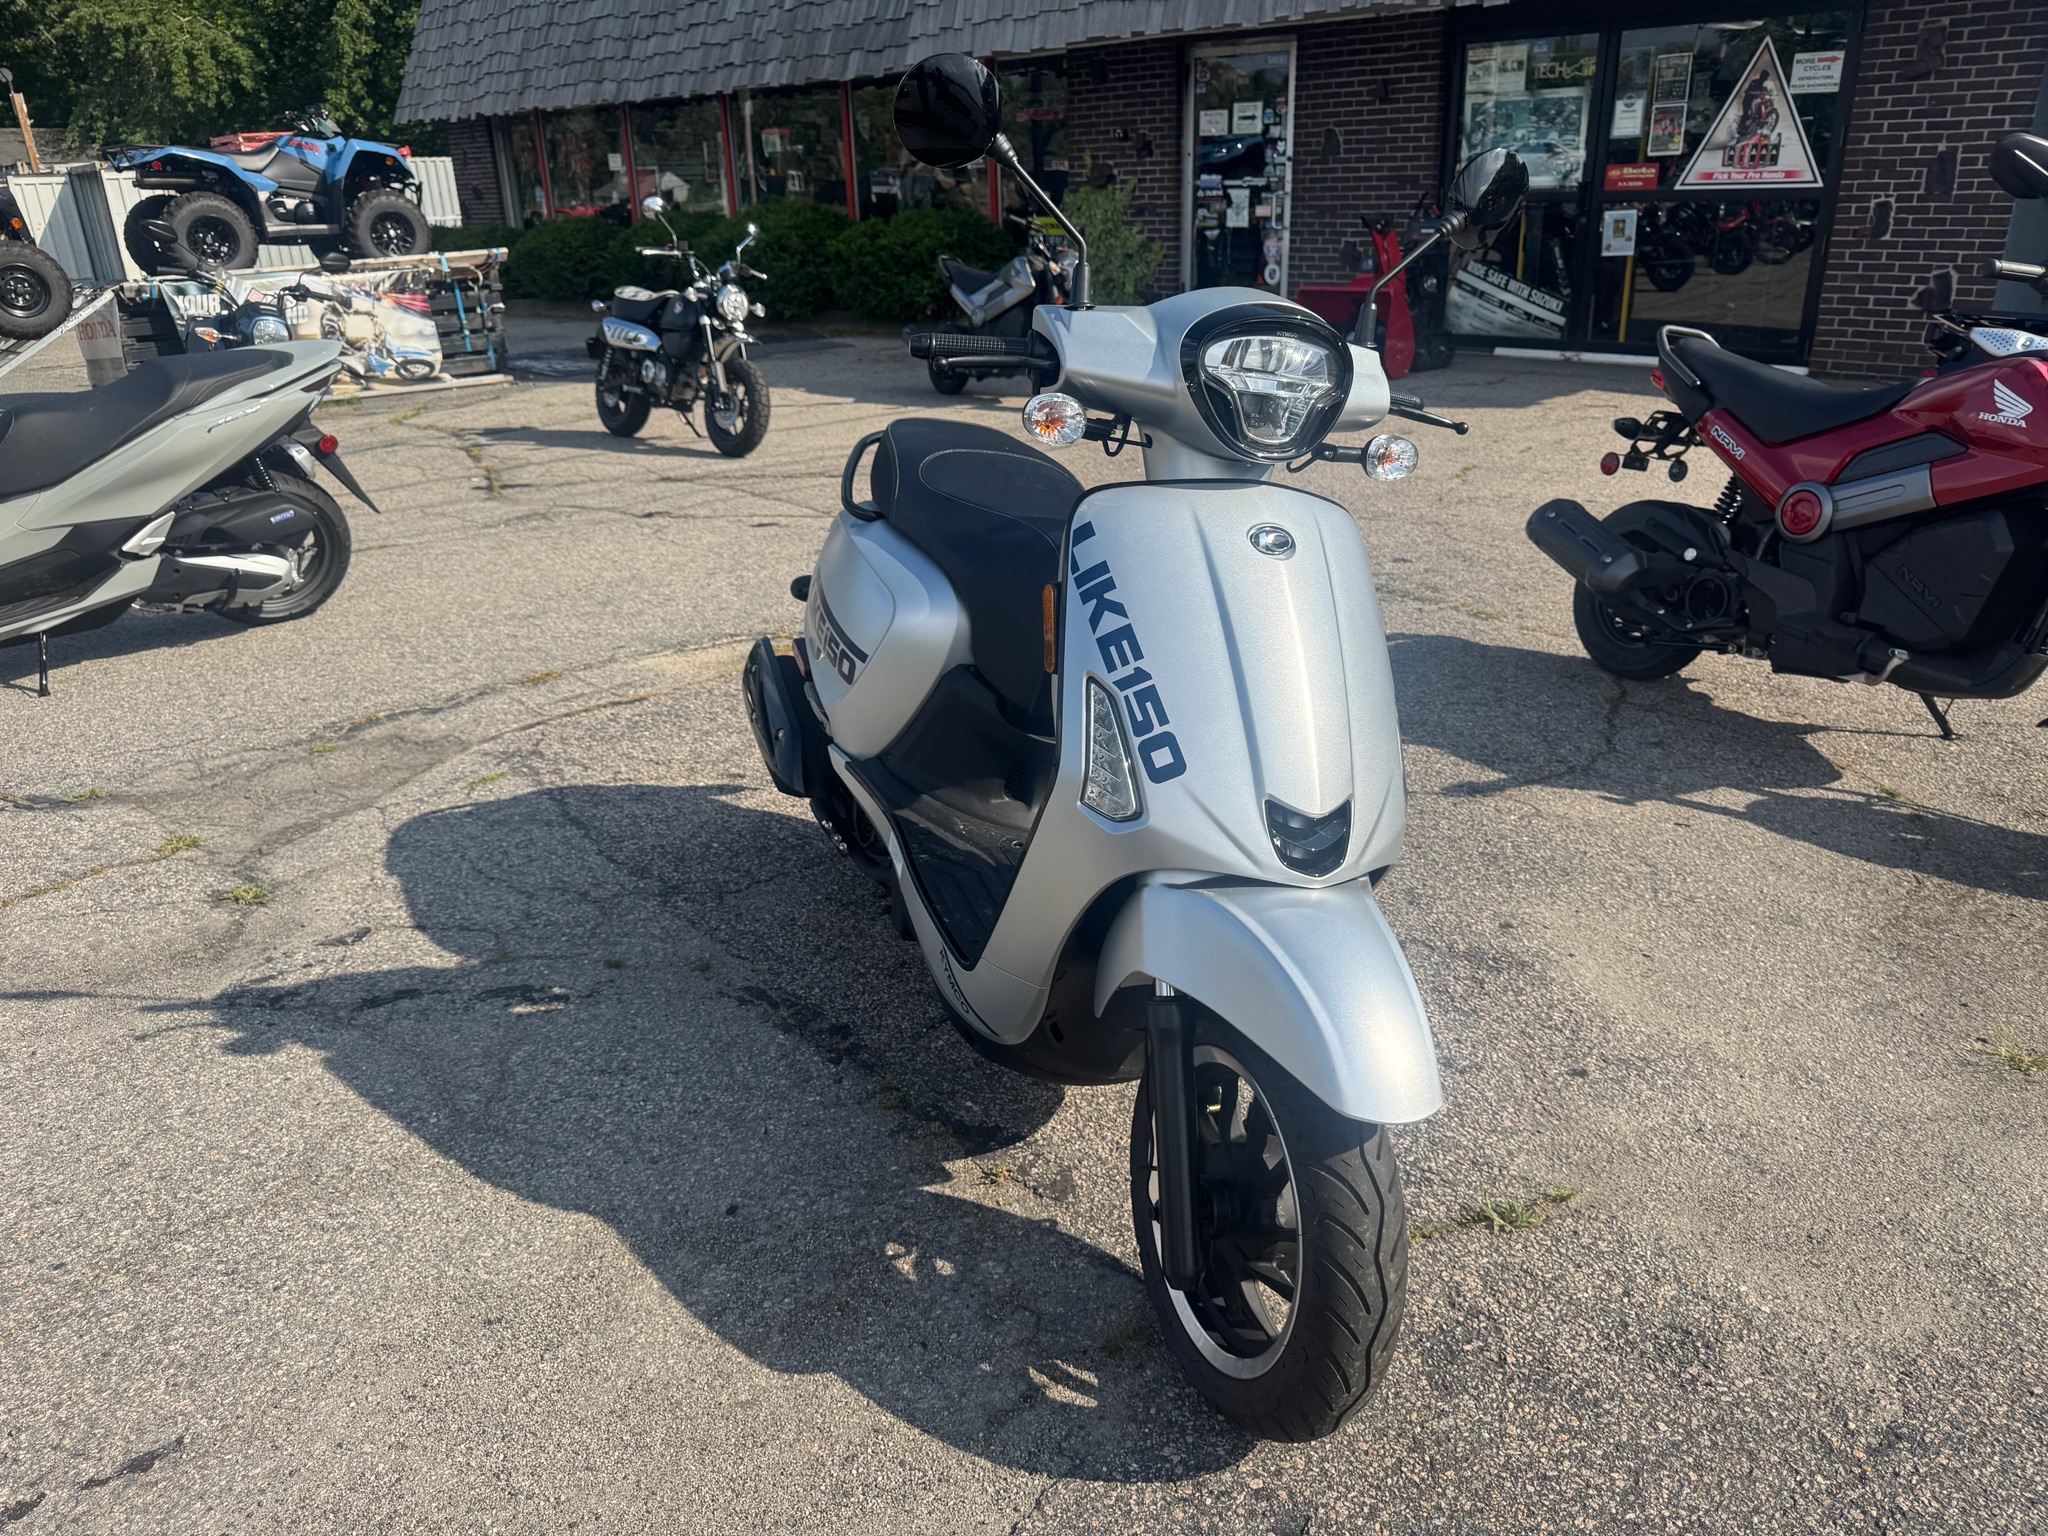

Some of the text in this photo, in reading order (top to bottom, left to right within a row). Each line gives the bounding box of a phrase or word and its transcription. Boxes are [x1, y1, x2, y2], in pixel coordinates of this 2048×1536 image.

[1712, 172, 1729, 180] Pick
[1747, 171, 1760, 179] Pro
[1486, 268, 1509, 289] SAFE
[1507, 277, 1532, 300] WITH
[1529, 288, 1564, 313] SUZUKI
[175, 293, 222, 317] YOUR
[77, 320, 117, 341] HONDA
[1977, 411, 2027, 428] HONDA
[1070, 520, 1187, 785] LIKE150
[940, 949, 970, 1014] KYMCO
